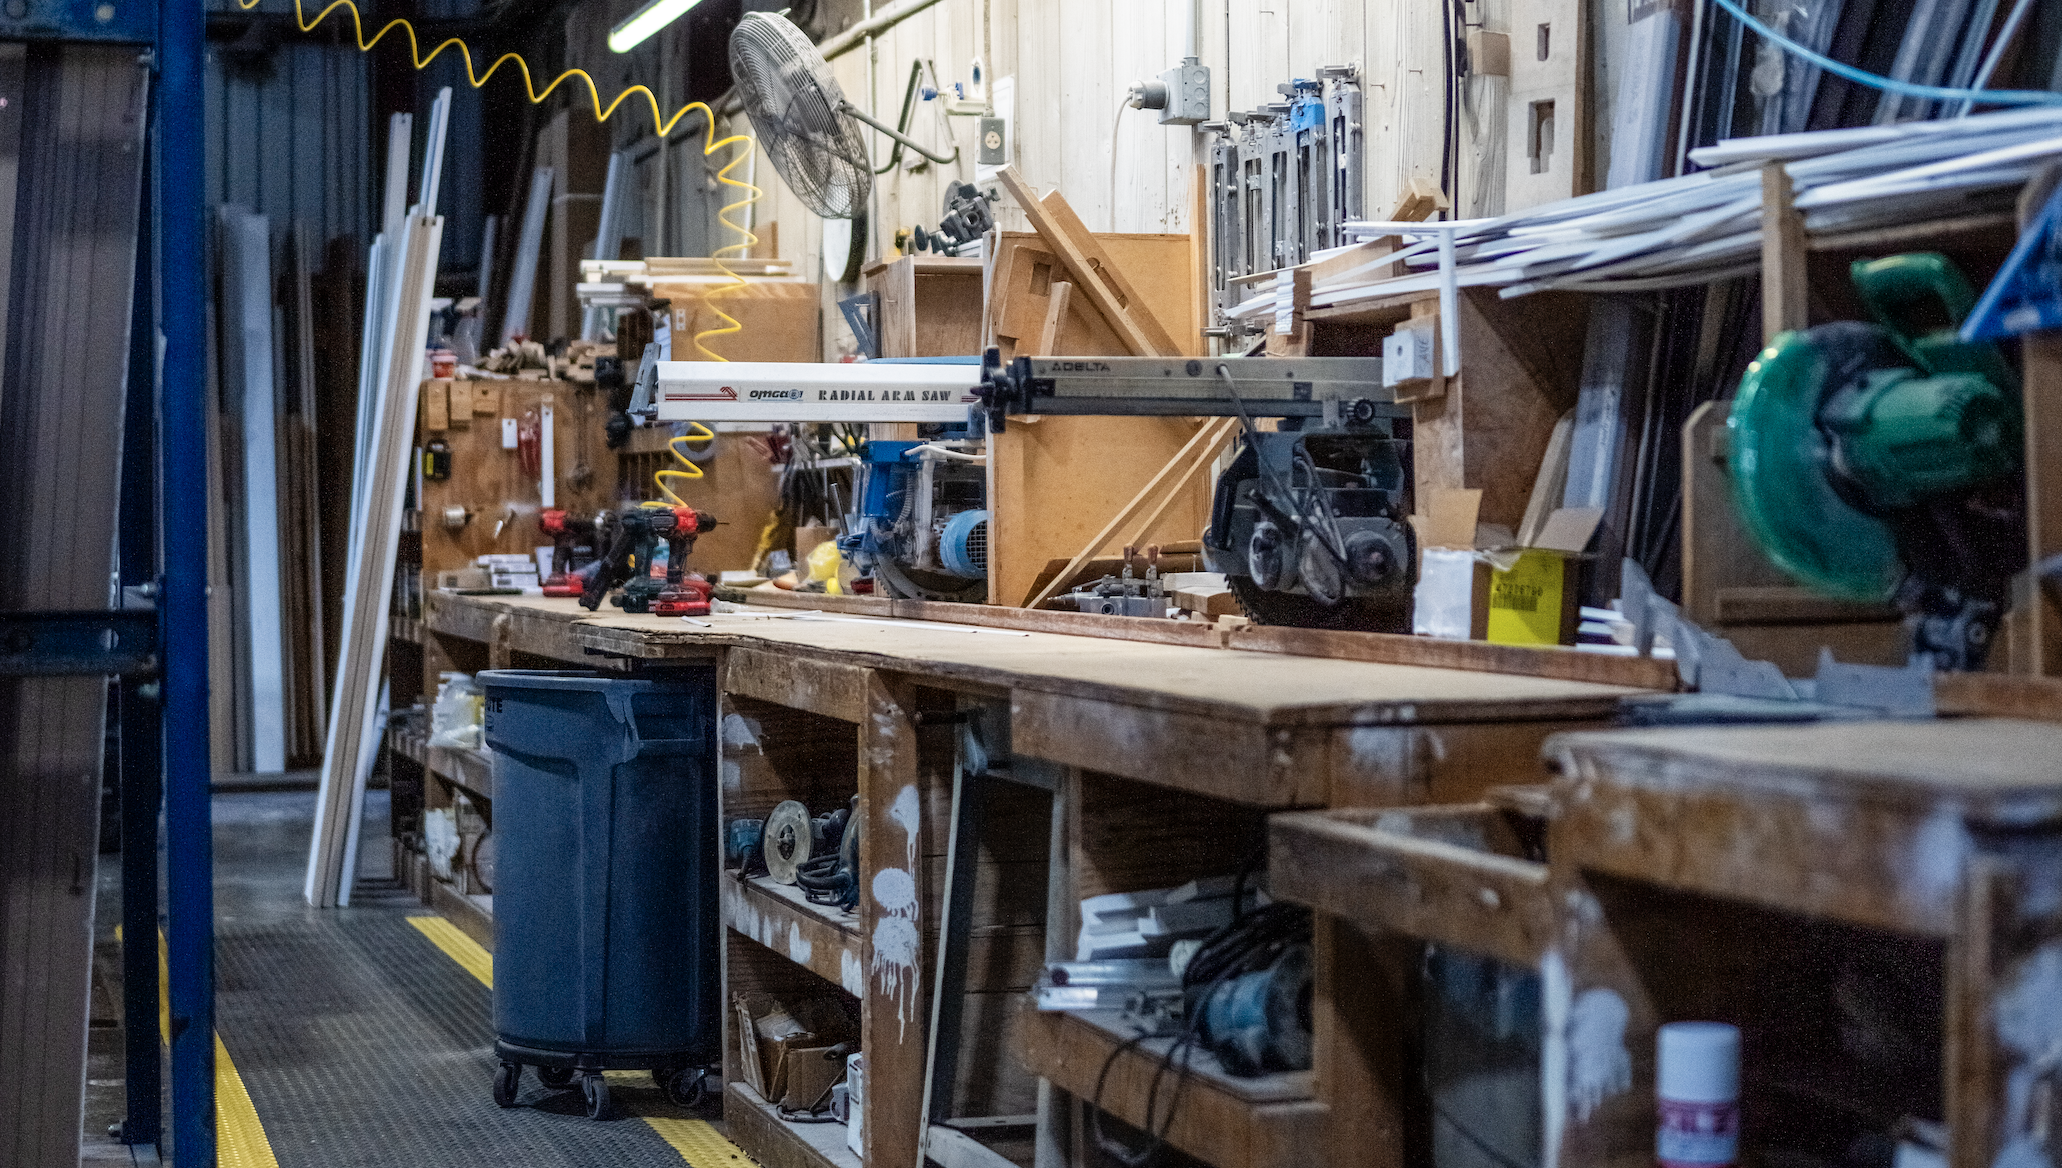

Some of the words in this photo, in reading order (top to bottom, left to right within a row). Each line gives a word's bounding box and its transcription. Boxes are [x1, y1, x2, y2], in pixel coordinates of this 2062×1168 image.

[1063, 362, 1111, 372] DELTA
[818, 390, 875, 401] RADIAL
[881, 390, 916, 401] ARM
[921, 390, 952, 401] SAW
